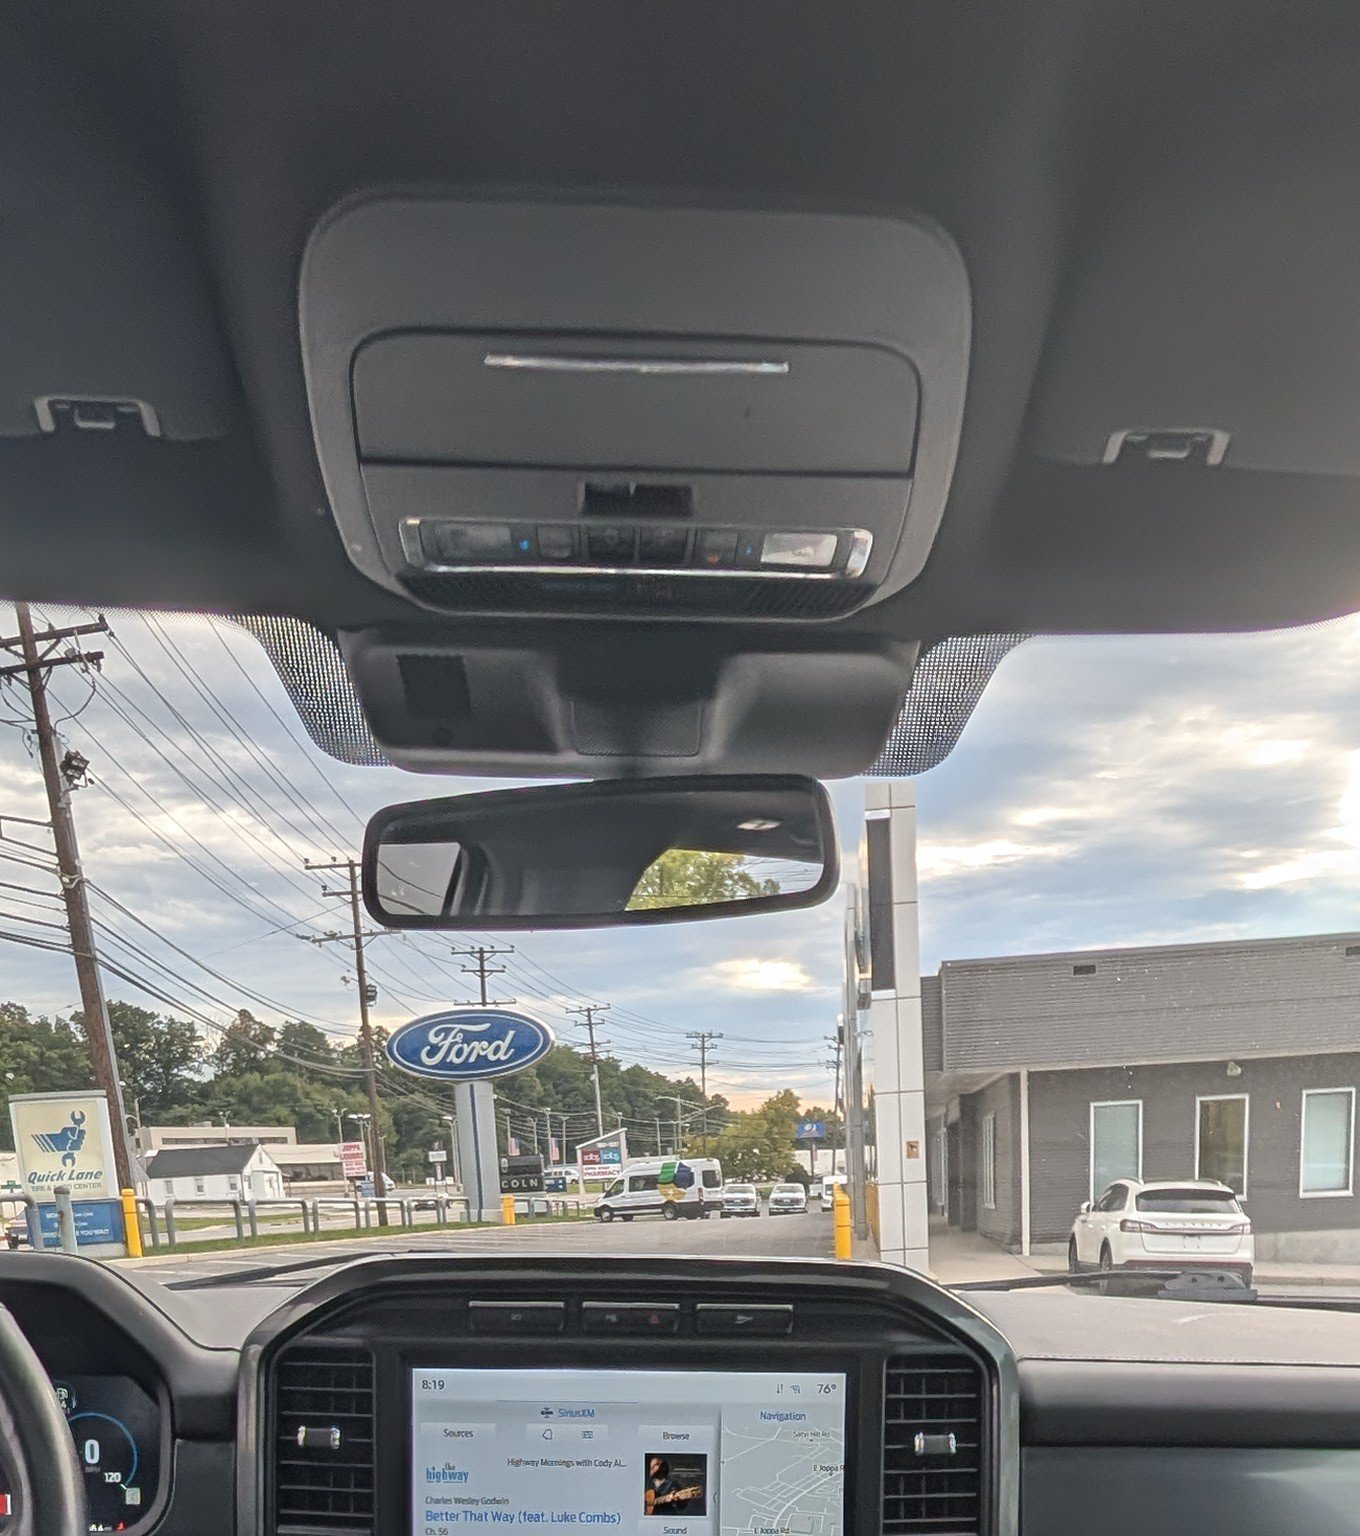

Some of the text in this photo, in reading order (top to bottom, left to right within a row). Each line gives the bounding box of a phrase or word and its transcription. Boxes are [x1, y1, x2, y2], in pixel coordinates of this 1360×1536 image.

[421, 1022, 516, 1066] Ford
[28, 1169, 103, 1184] Quick Lane
[421, 1379, 445, 1390] 8:19
[817, 1383, 837, 1395] 76°
[558, 1408, 595, 1418] SiriusXM
[760, 1411, 806, 1422] Navigation
[443, 1428, 474, 1438] Sources
[662, 1431, 690, 1440] Browse
[84, 1439, 100, 1465] 0
[507, 1458, 539, 1468] Highway
[540, 1458, 574, 1468] Mornings
[575, 1459, 593, 1467] with
[104, 1472, 122, 1483] 120
[426, 1466, 469, 1483] highway
[425, 1497, 509, 1506] Charles Wesley Godwin
[425, 1510, 621, 1525] Better That Way (feat. Luke Combs)
[663, 1526, 688, 1535] Sound
